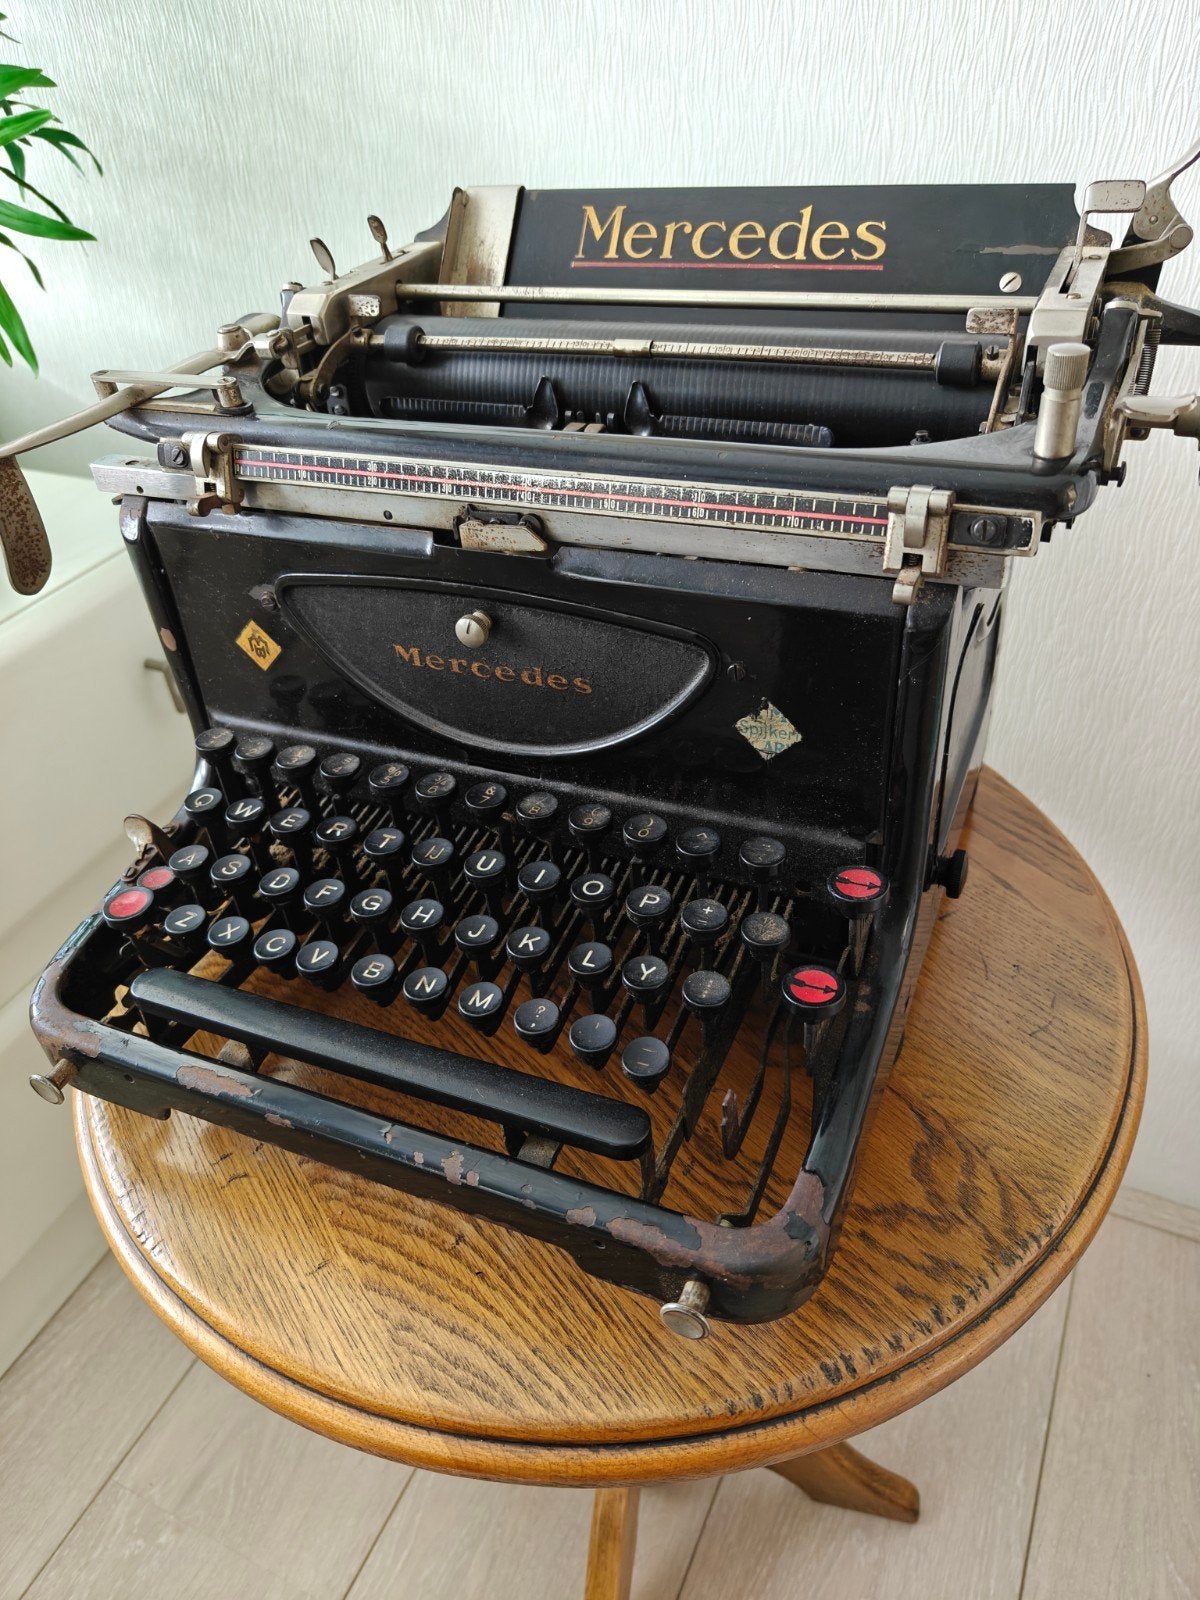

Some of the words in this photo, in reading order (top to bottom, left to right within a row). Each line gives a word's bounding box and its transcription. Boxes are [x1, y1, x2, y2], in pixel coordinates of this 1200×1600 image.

[574, 204, 887, 261] Mercedes
[367, 476, 378, 486] 20
[691, 507, 705, 518] 60
[786, 516, 800, 527] 70
[392, 643, 594, 695] Mercedes
[380, 775, 391, 784] 5
[427, 784, 438, 794] 6
[485, 785, 497, 796] &
[195, 793, 214, 808] Q
[235, 803, 261, 817] W
[528, 805, 541, 815] 8
[281, 814, 303, 827] E
[582, 817, 594, 826] 9
[326, 823, 347, 836] R
[379, 834, 396, 848] T
[178, 853, 195, 865] A
[425, 846, 444, 859] IJ
[222, 861, 241, 874] S
[477, 856, 496, 870] U
[269, 873, 290, 888] D
[535, 870, 545, 883] I
[315, 886, 338, 899] F
[583, 880, 604, 895] O
[362, 896, 382, 910] G
[640, 894, 660, 907] P
[411, 906, 434, 922] H
[702, 906, 714, 915] +
[175, 912, 198, 927] Z
[218, 924, 240, 939] X
[468, 924, 485, 937] J
[267, 937, 286, 951] C
[519, 934, 540, 950] K
[312, 948, 329, 963] V
[582, 950, 595, 967] L
[361, 962, 385, 979] B
[641, 963, 656, 980] Y
[415, 976, 437, 992] N
[468, 990, 494, 1009] M
[535, 1004, 547, 1018] ?
